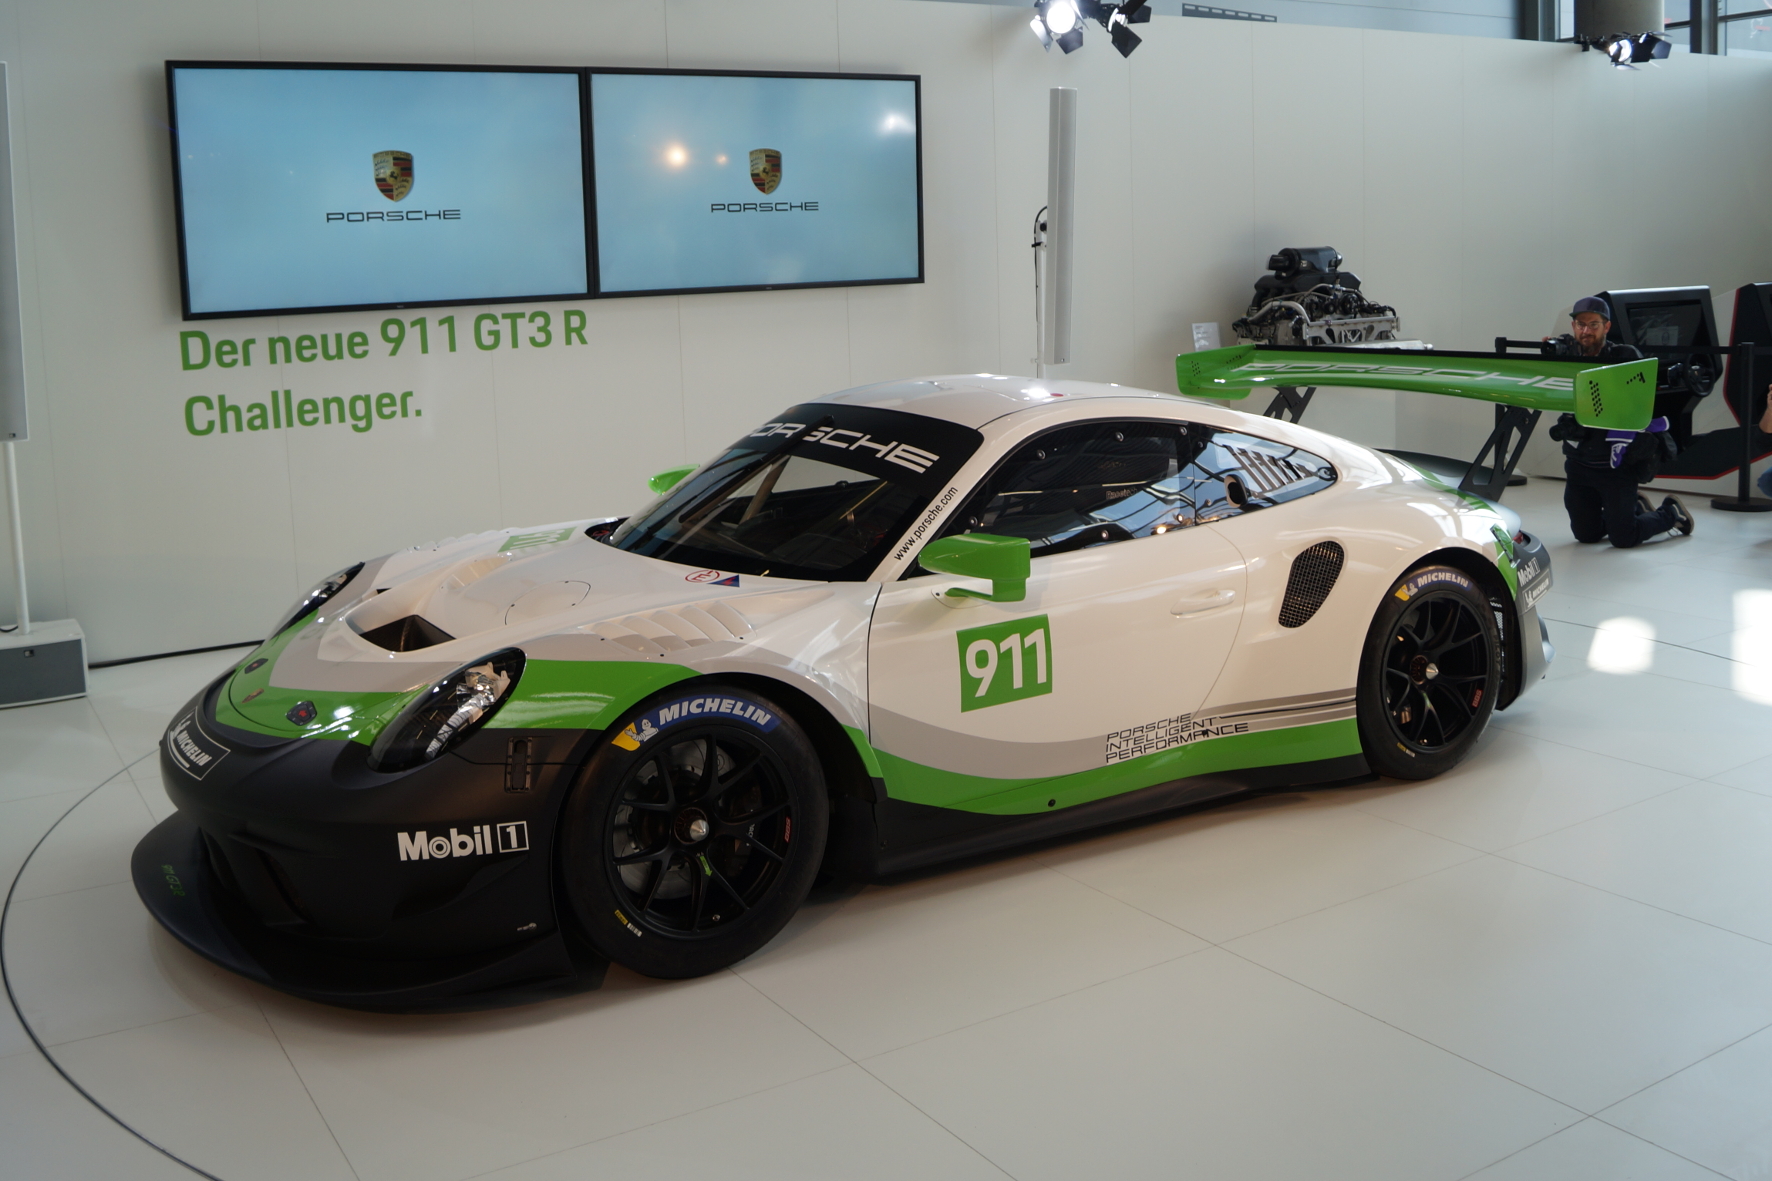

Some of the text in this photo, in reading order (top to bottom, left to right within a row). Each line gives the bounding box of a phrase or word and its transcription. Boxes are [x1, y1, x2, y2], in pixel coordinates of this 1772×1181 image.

[326, 209, 461, 223] PORSCHE
[711, 201, 819, 213] PORSCHE
[179, 309, 589, 371] Der neue 911 GT3 R
[1230, 363, 1574, 391] PORSCHE
[184, 389, 423, 437] Challenger.
[750, 422, 940, 474] ORSCHE
[893, 486, 959, 562] www.porsche.com
[1416, 572, 1469, 588] MICHELIN
[1517, 561, 1536, 587] Mobil
[1532, 578, 1549, 599] MICHELIN
[965, 627, 1047, 698] 911
[658, 697, 771, 726] MICHELIN
[1106, 712, 1192, 742] PORSCHE
[176, 730, 212, 766] MICHELIN
[1105, 722, 1249, 763] PERFORMANCE
[1106, 716, 1217, 752] INTELLIGENT
[397, 825, 493, 861] Mobil
